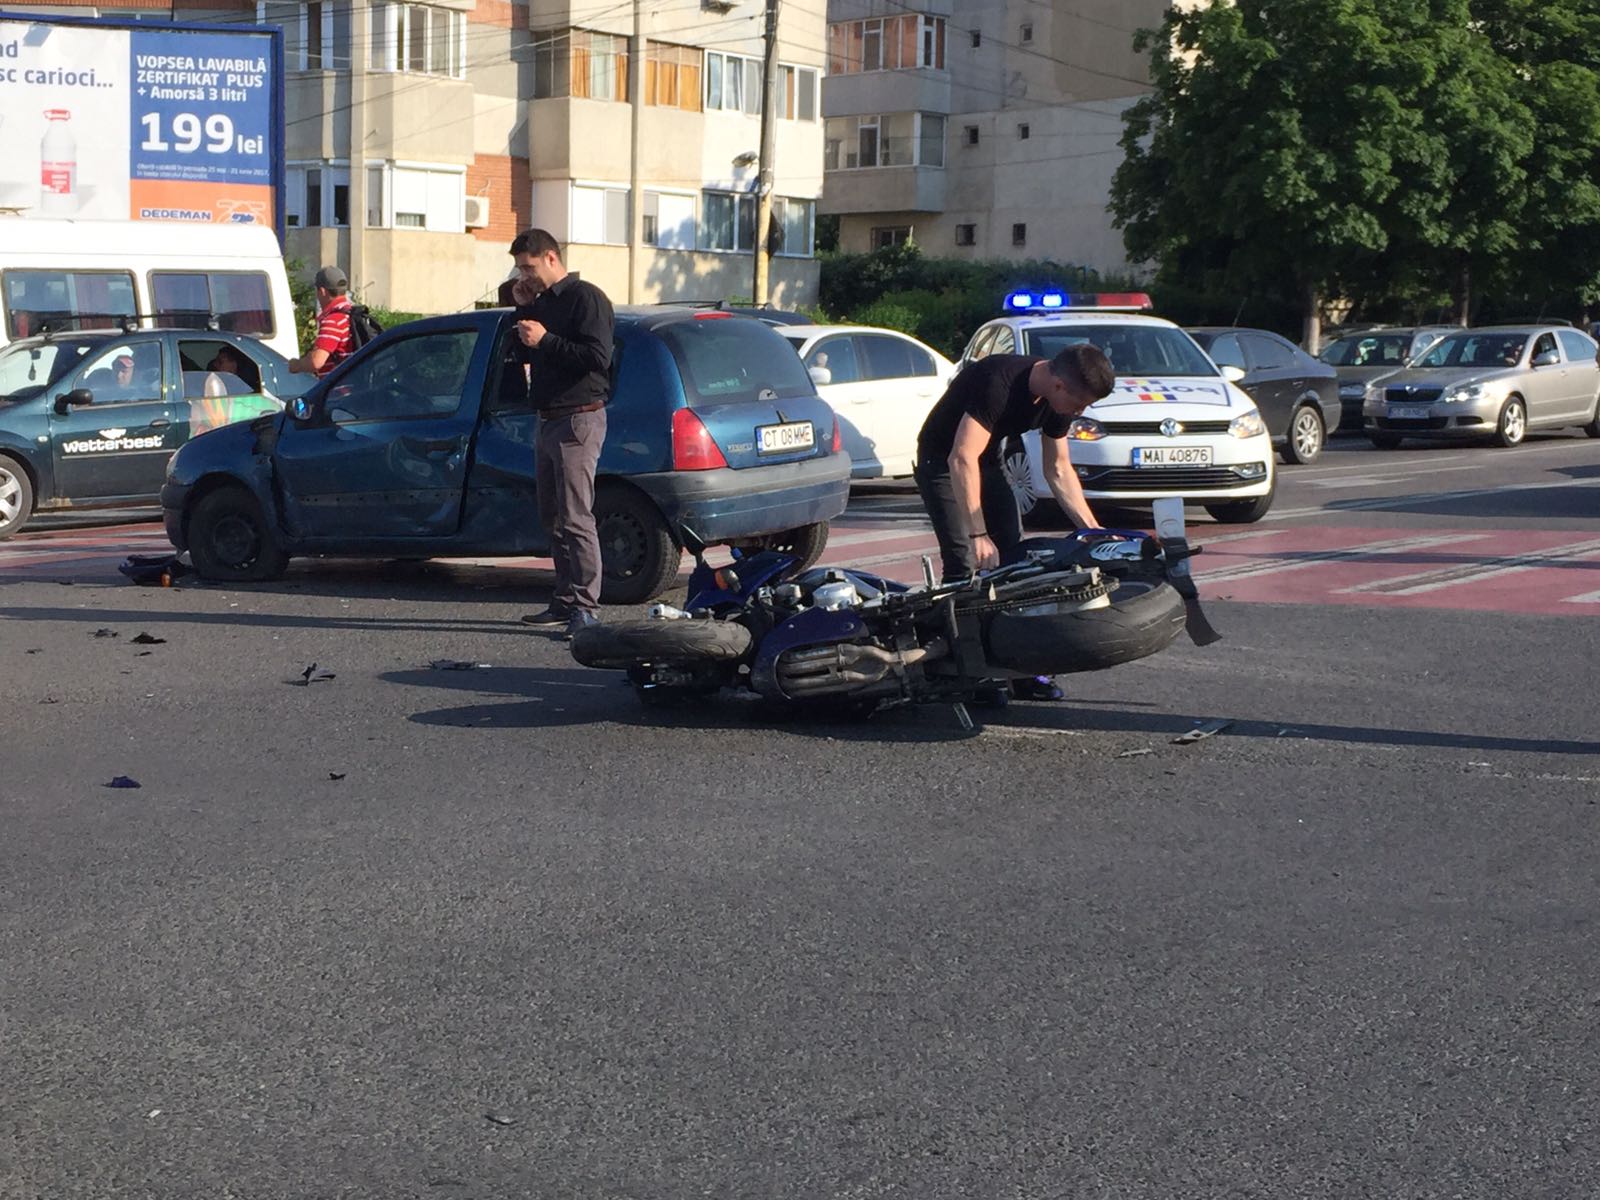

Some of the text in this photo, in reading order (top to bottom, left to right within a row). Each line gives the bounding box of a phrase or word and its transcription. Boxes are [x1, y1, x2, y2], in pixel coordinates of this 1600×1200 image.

[136, 54, 267, 73] VOPSEA LAVABILĂ
[24, 67, 113, 88] carioci...
[136, 70, 263, 88] ZERTIFIKAT PLUS
[137, 86, 247, 102] + Amorsă 3 litri
[141, 111, 263, 155] 199 lei
[141, 209, 212, 221] DEDEMAN
[764, 429, 778, 448] CT
[781, 427, 793, 446] 08
[1143, 448, 1209, 463] MAI 40876
